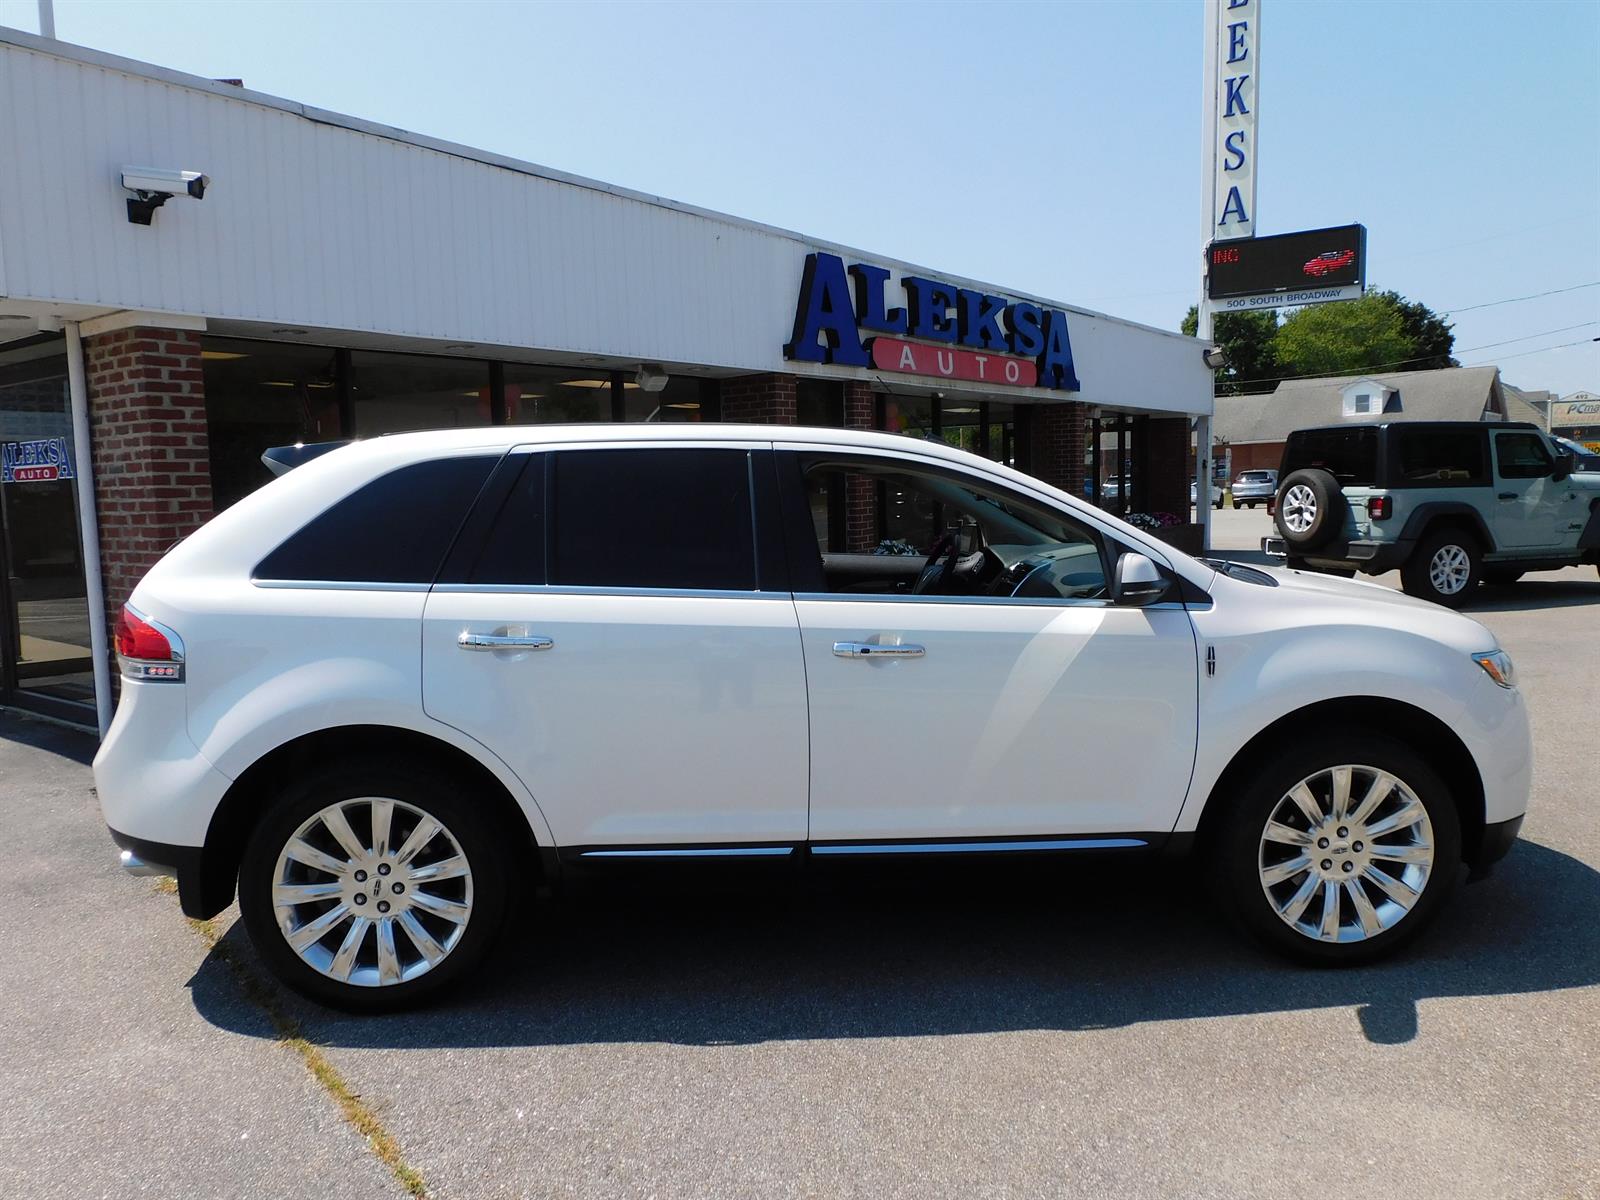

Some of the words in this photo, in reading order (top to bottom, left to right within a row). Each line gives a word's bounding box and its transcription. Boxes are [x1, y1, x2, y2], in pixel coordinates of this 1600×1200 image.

[1218, 0, 1250, 226] EKSA
[1227, 299, 1246, 308] 500
[1250, 295, 1283, 305] SOUTH
[1287, 289, 1342, 302] BROADWAY
[783, 252, 1080, 392] ALEKSA
[899, 345, 1019, 383] AUTO
[2, 436, 73, 483] ALEKSA
[20, 469, 50, 479] AUTO
